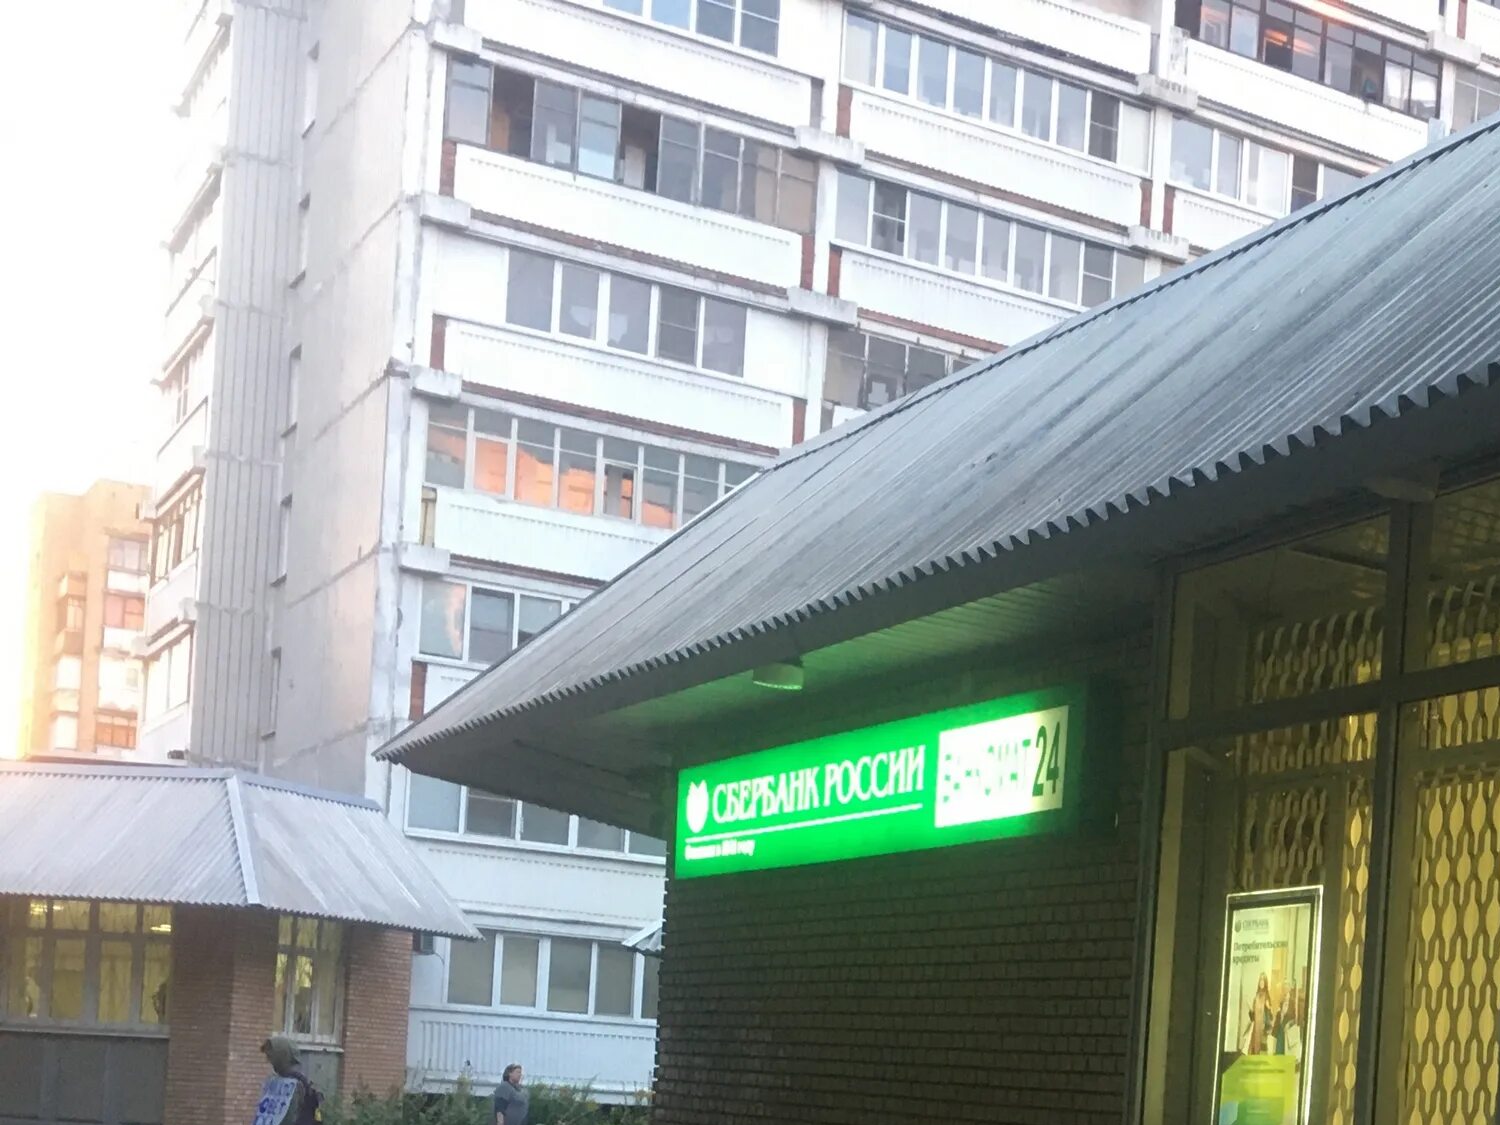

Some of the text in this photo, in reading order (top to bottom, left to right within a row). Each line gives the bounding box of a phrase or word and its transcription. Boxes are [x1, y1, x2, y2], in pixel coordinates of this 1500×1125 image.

[711, 745, 927, 824] СБЕРБАНК РОССИИ
[1032, 722, 1061, 798] 24
